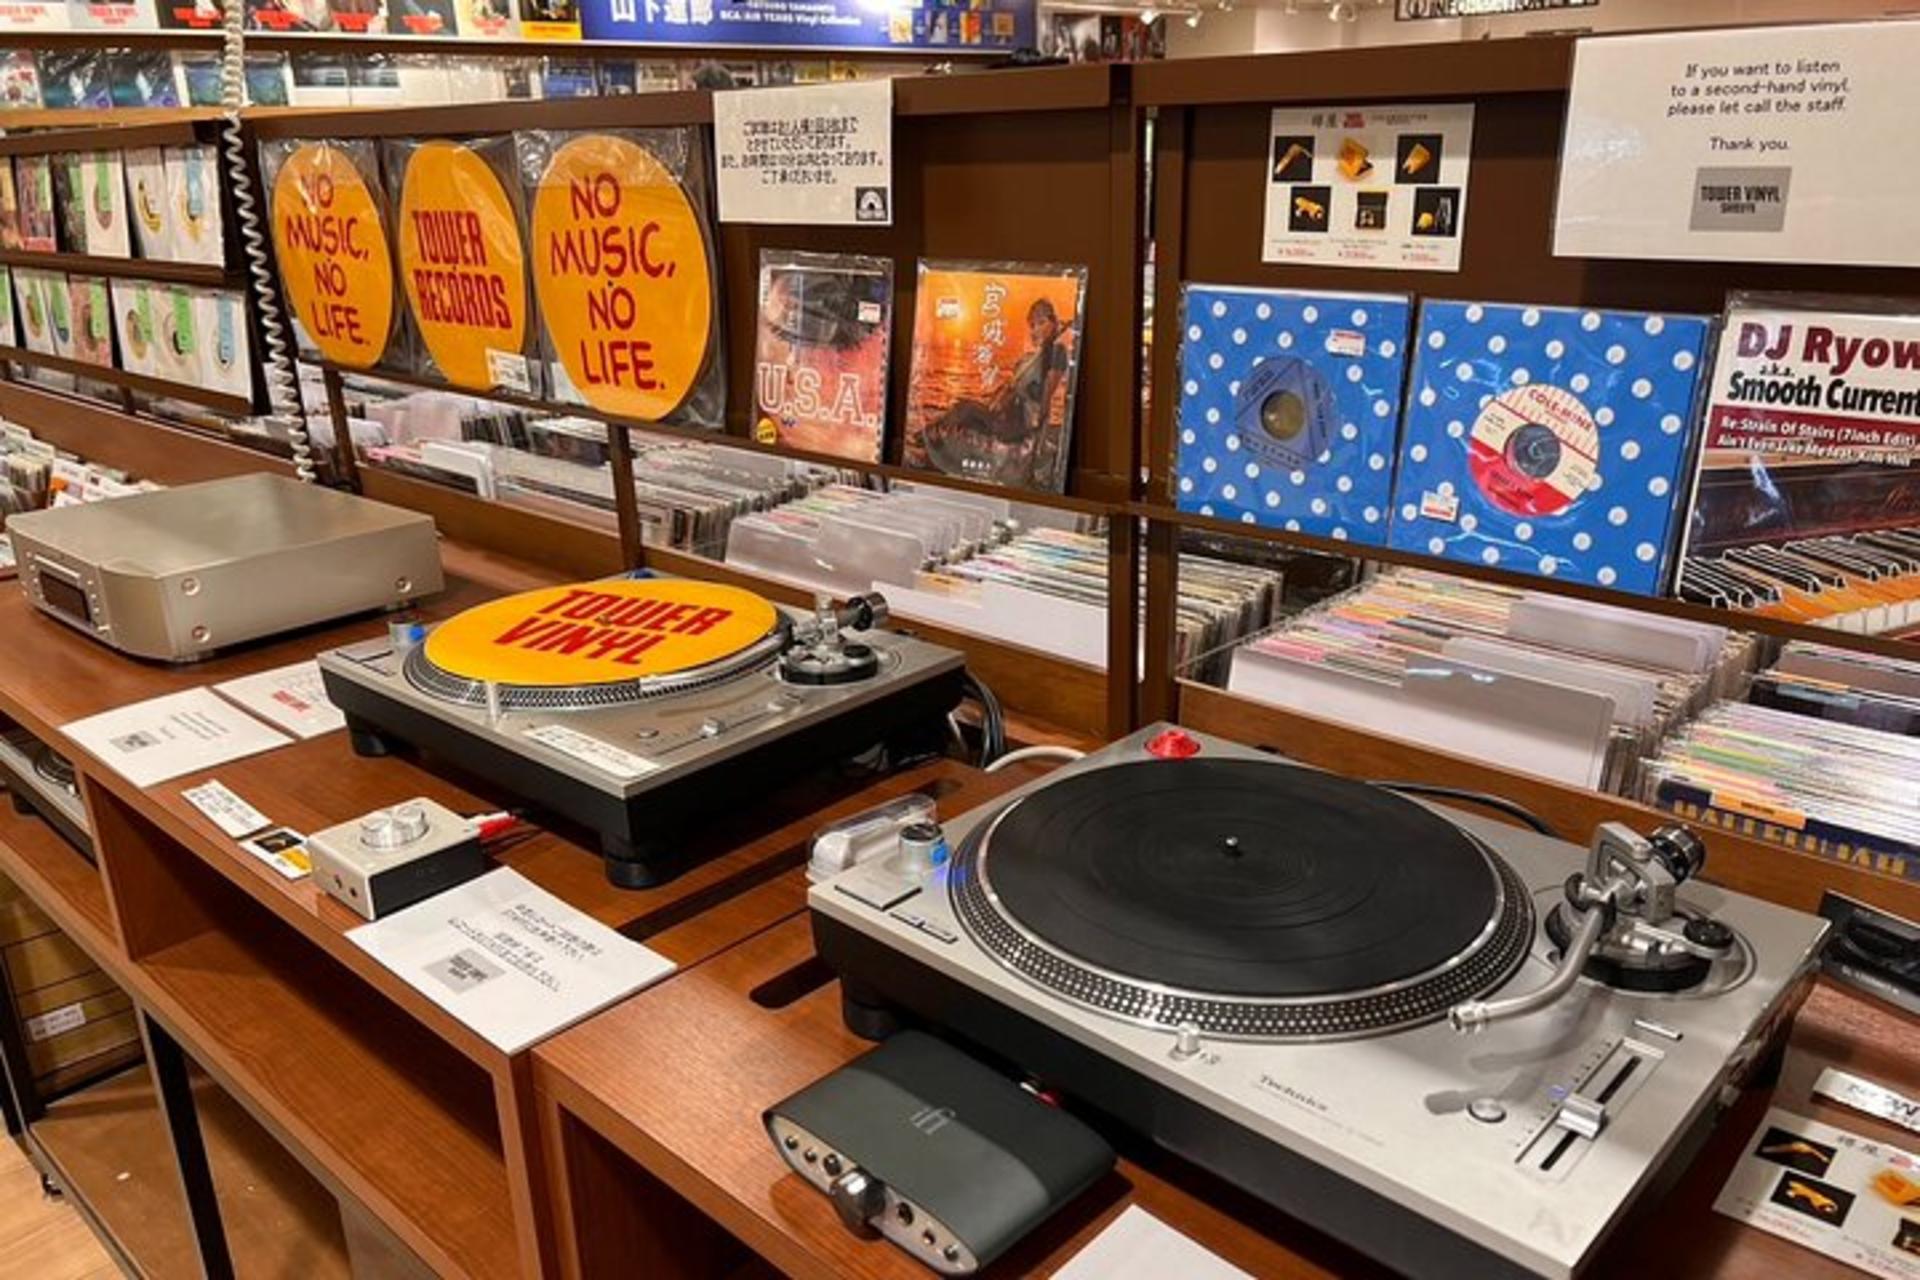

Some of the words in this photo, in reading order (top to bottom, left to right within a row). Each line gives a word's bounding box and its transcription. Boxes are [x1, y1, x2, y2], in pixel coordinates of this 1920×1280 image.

[1671, 85, 1686, 97] to
[1690, 86, 1700, 96] a
[1705, 79, 1806, 96] second-hand
[1685, 63, 1699, 78] If
[1701, 65, 1728, 80] you
[1733, 63, 1769, 76] want
[1775, 62, 1792, 75] to
[1796, 59, 1840, 73] listen
[1667, 101, 1715, 117] please
[1719, 101, 1740, 114] let
[1744, 99, 1771, 113] call
[1775, 98, 1801, 112] the
[1710, 136, 1754, 150] Thank
[300, 173, 335, 208] NO
[570, 172, 621, 220] NO
[1701, 185, 1742, 201] TOWER
[1744, 185, 1780, 202] VINYL
[286, 215, 369, 261] MUSIC,
[412, 210, 487, 267] TOWER
[551, 222, 677, 279] MUSIC,
[313, 263, 347, 296] NO
[413, 268, 512, 329] RECORDS
[311, 301, 371, 346] LIFE.
[588, 287, 636, 331] NO
[580, 340, 665, 391] LIFE.
[1737, 322, 1793, 360] DJ
[1802, 326, 1920, 376] Ryow
[1760, 363, 1795, 377] a.k.a.
[757, 362, 877, 427] U.S.A.
[1727, 371, 1822, 406] Smooth
[1826, 379, 1920, 417] Current
[1781, 422, 1796, 434] Of
[1799, 423, 1835, 439] Stairs
[536, 589, 733, 636] TOWER
[494, 617, 665, 665] VINYL
